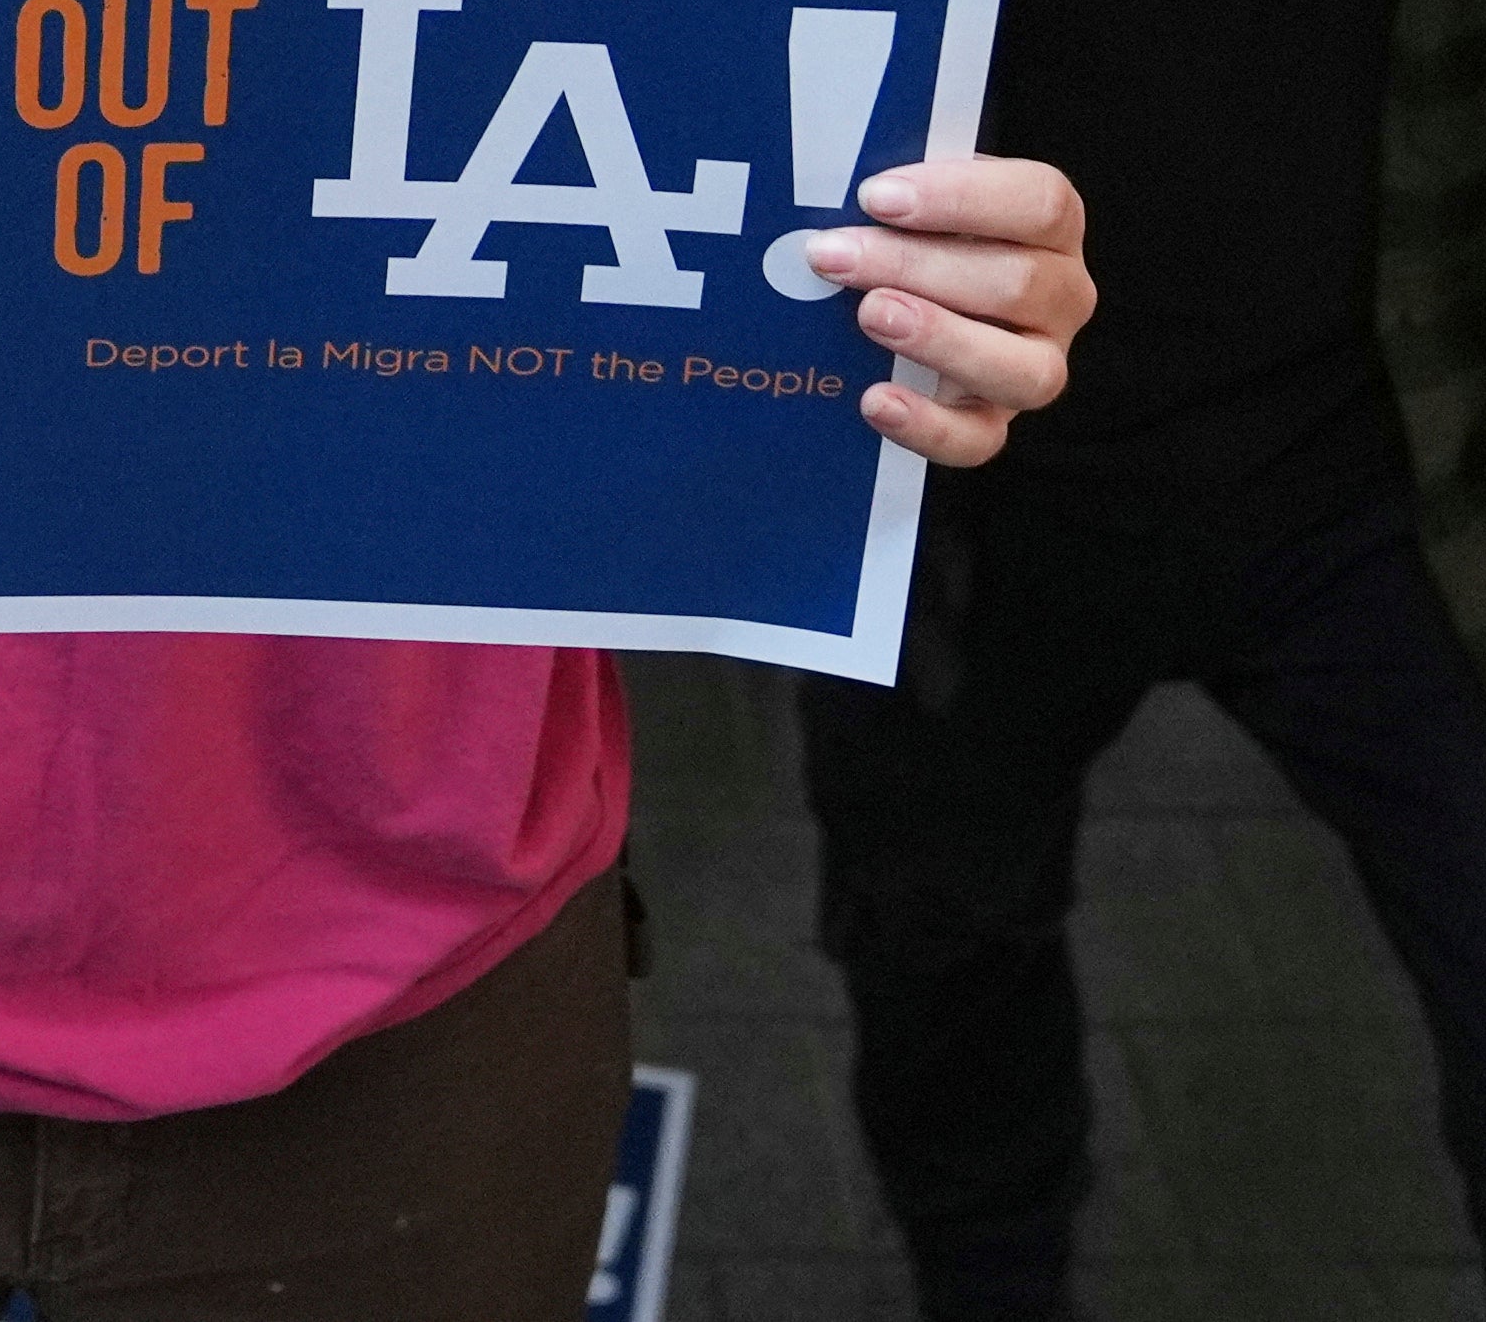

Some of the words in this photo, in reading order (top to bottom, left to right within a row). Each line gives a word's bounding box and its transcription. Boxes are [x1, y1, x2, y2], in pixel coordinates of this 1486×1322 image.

[51, 142, 206, 277] OF
[86, 338, 249, 373] Deport
[267, 338, 304, 369] la
[323, 340, 450, 376] Migra
[469, 345, 575, 377] NOT
[591, 351, 665, 383] the
[682, 356, 844, 398] People
